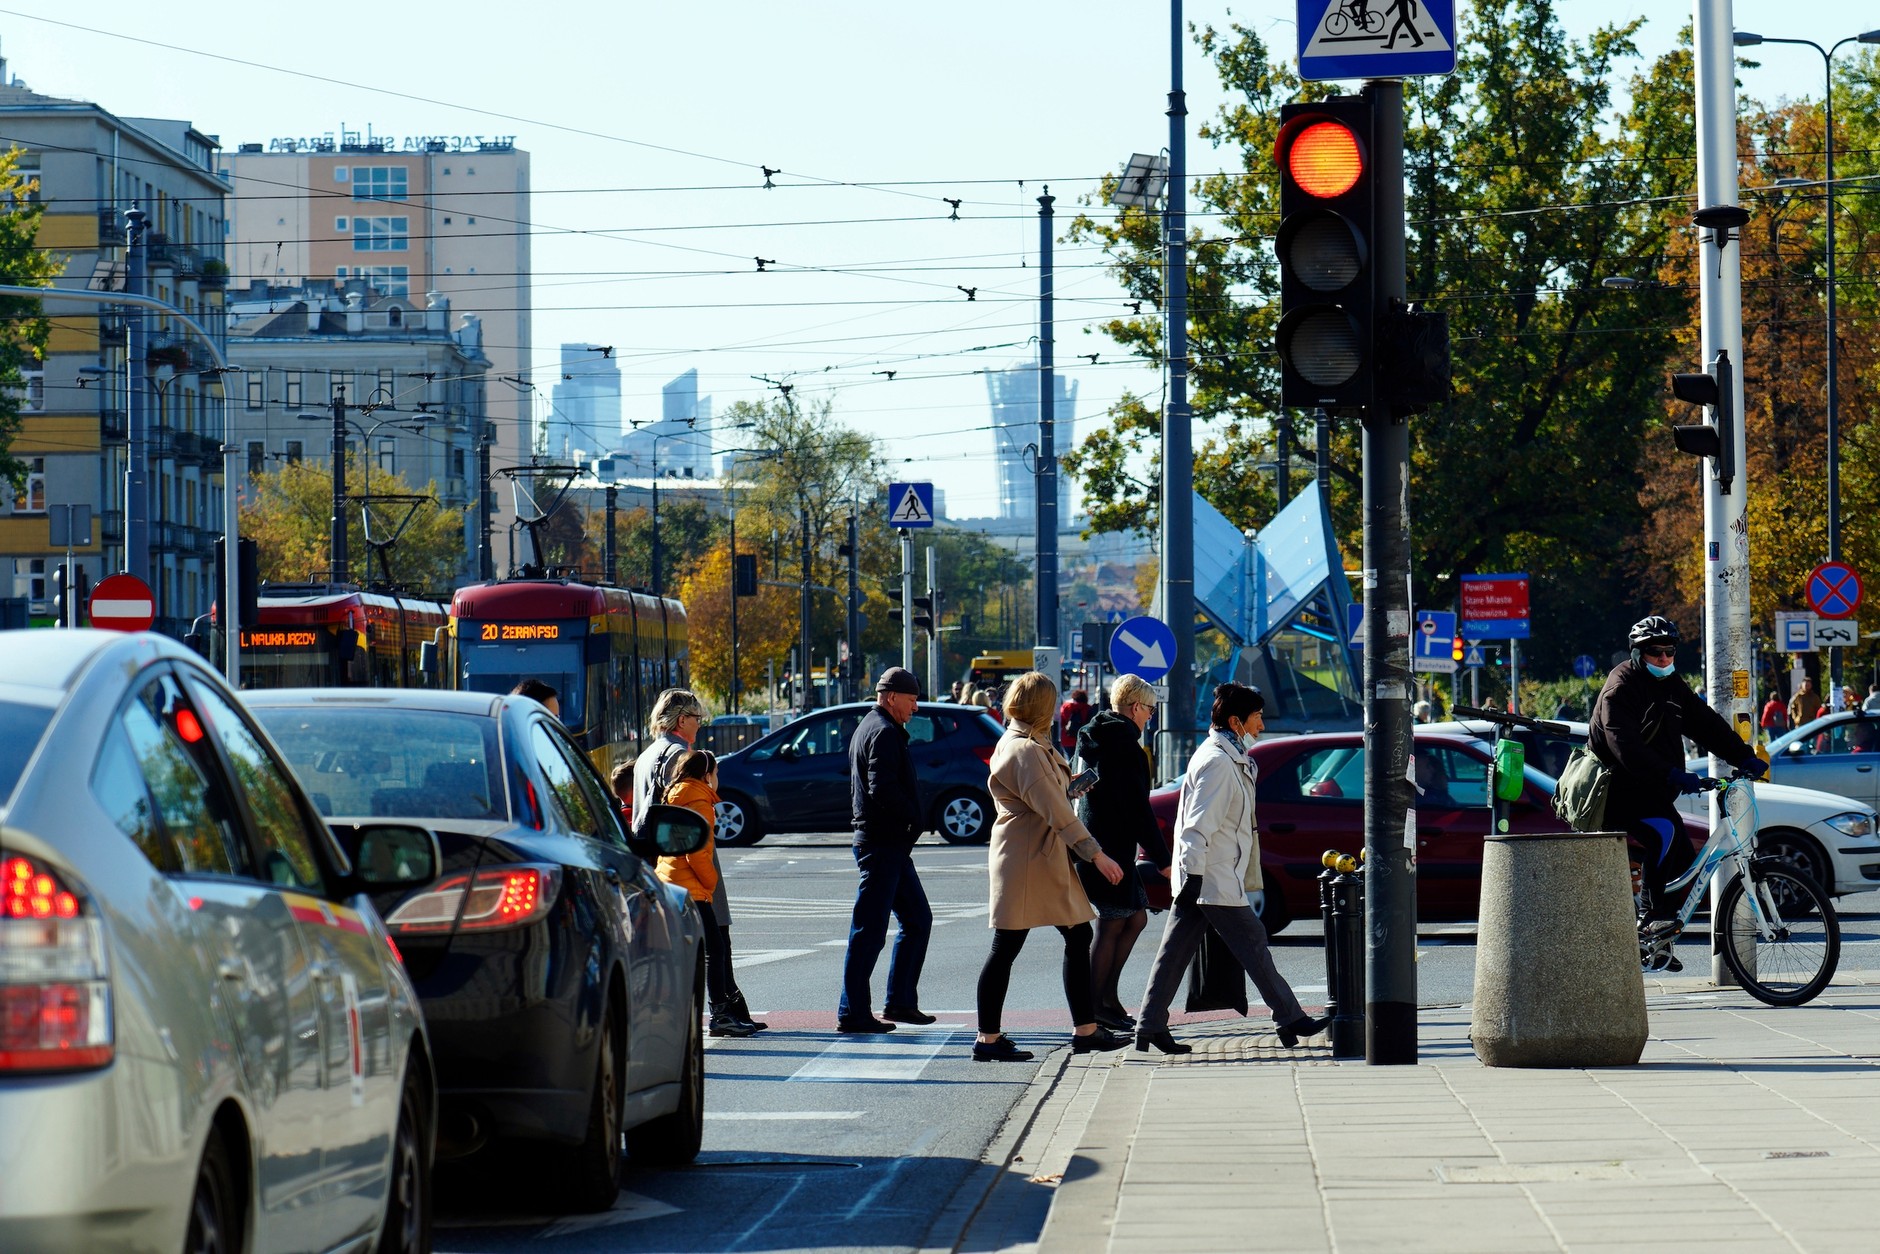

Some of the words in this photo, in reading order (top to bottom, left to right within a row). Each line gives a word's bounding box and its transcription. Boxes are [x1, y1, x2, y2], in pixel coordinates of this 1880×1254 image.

[1464, 595, 1484, 605] Stare
[1486, 595, 1513, 605] Miasto
[481, 623, 499, 640] 20
[537, 625, 558, 639] FSO
[250, 633, 286, 646] NAUKA
[286, 632, 316, 646] JAZDY
